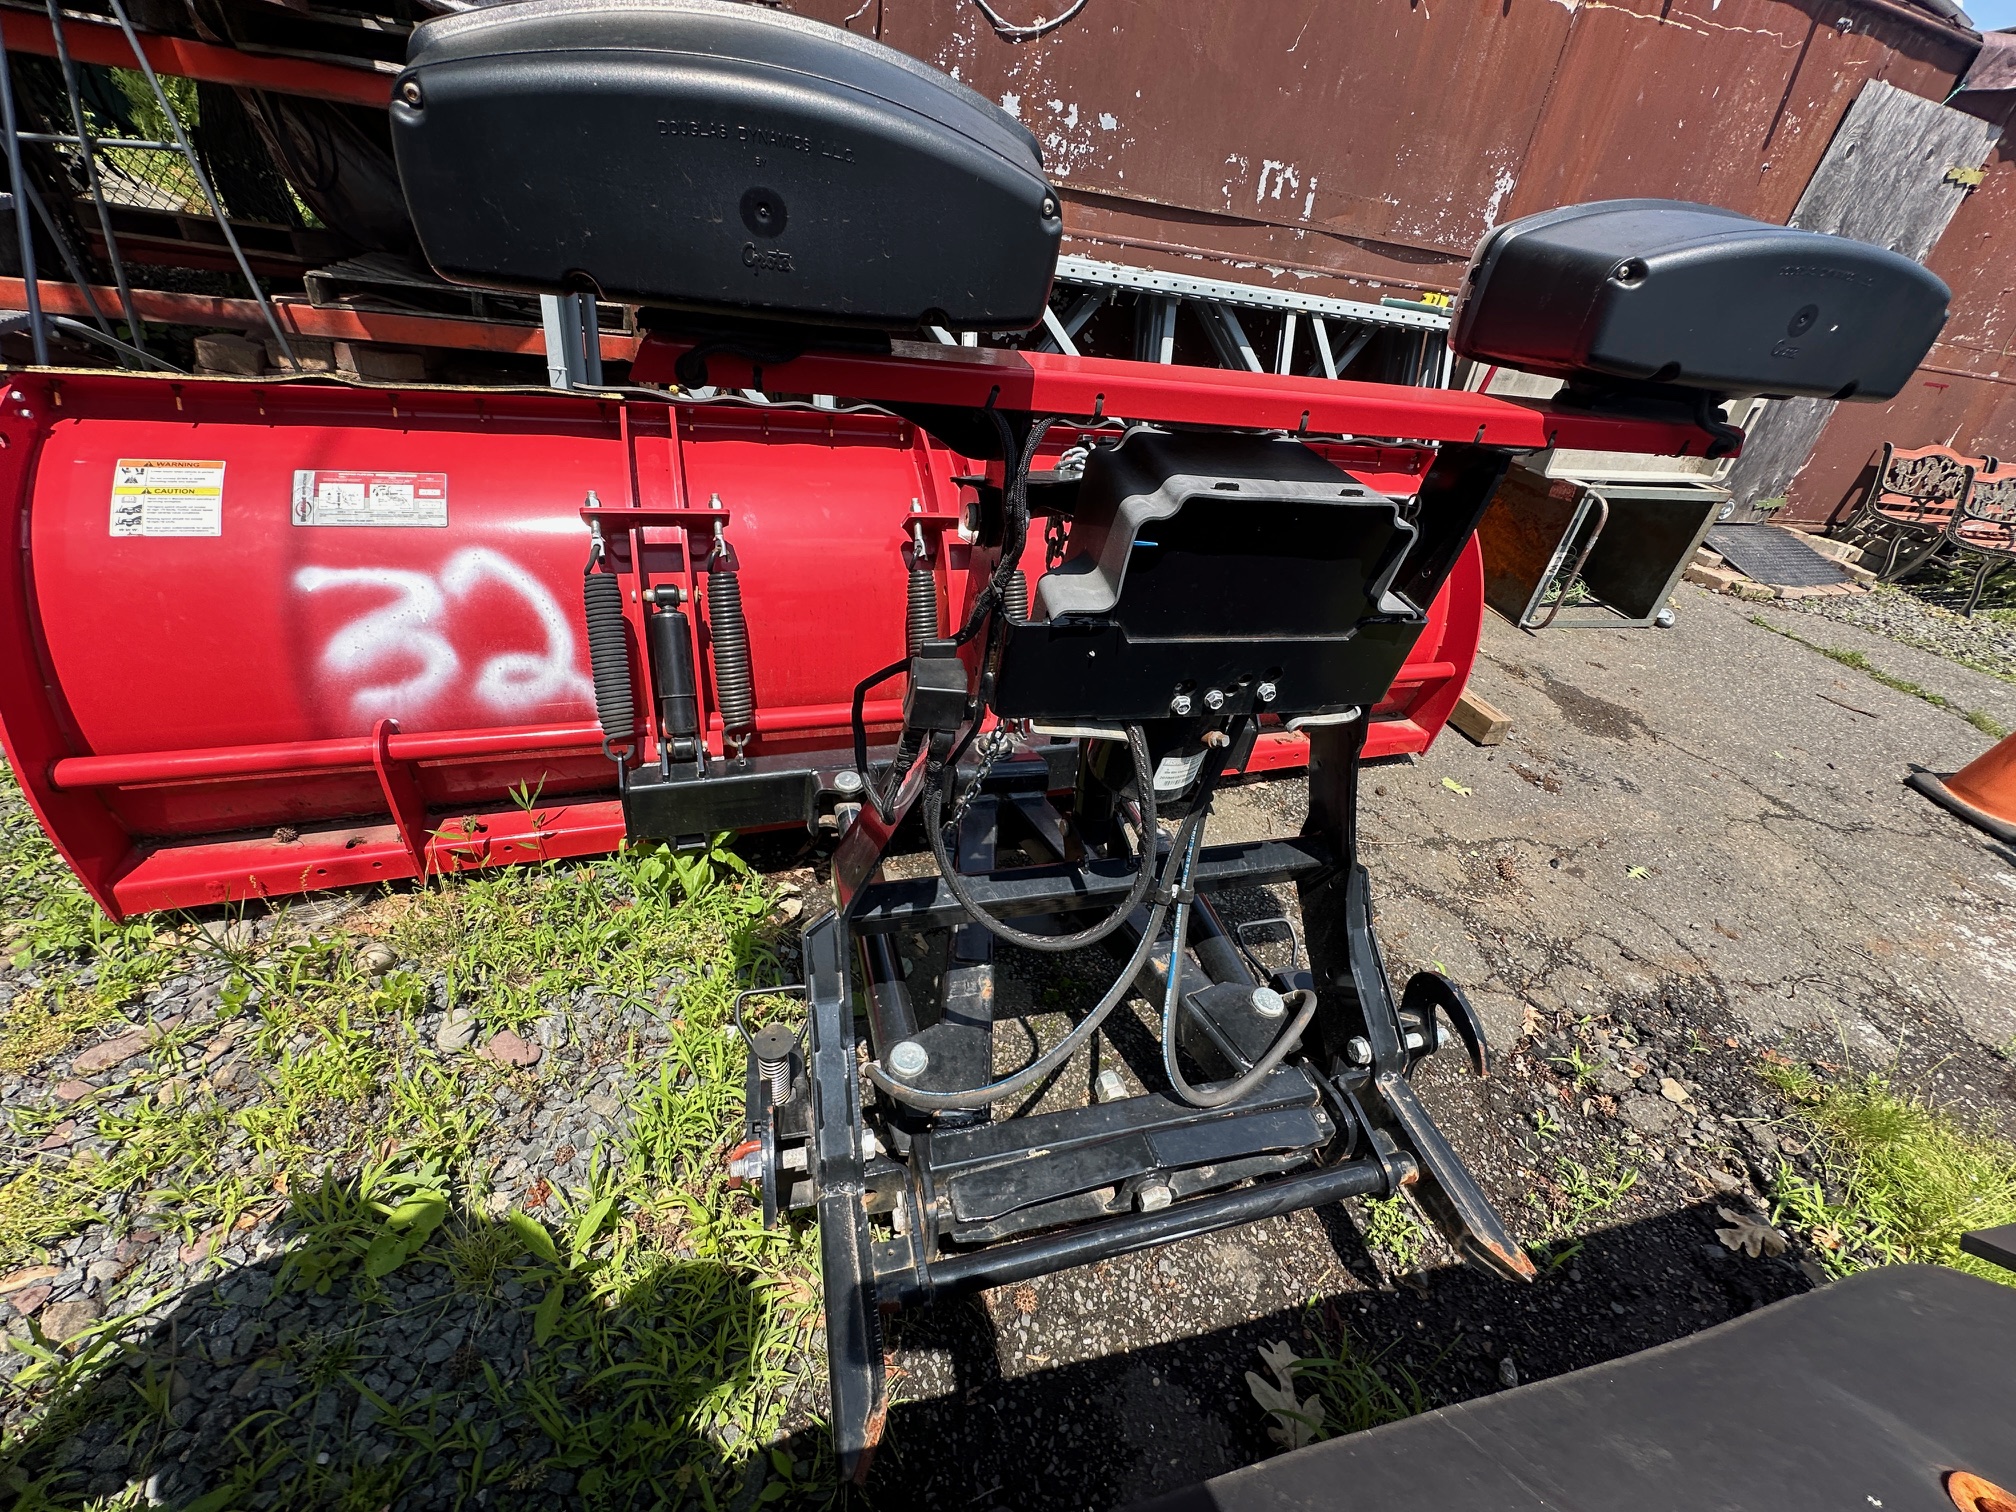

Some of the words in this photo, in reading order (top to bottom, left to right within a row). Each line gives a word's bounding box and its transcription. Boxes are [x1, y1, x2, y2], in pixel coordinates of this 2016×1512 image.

[657, 120, 728, 139] DOUGLAS
[738, 125, 812, 152] DYNAMICS
[754, 155, 767, 167] BY
[294, 546, 594, 712] 32
